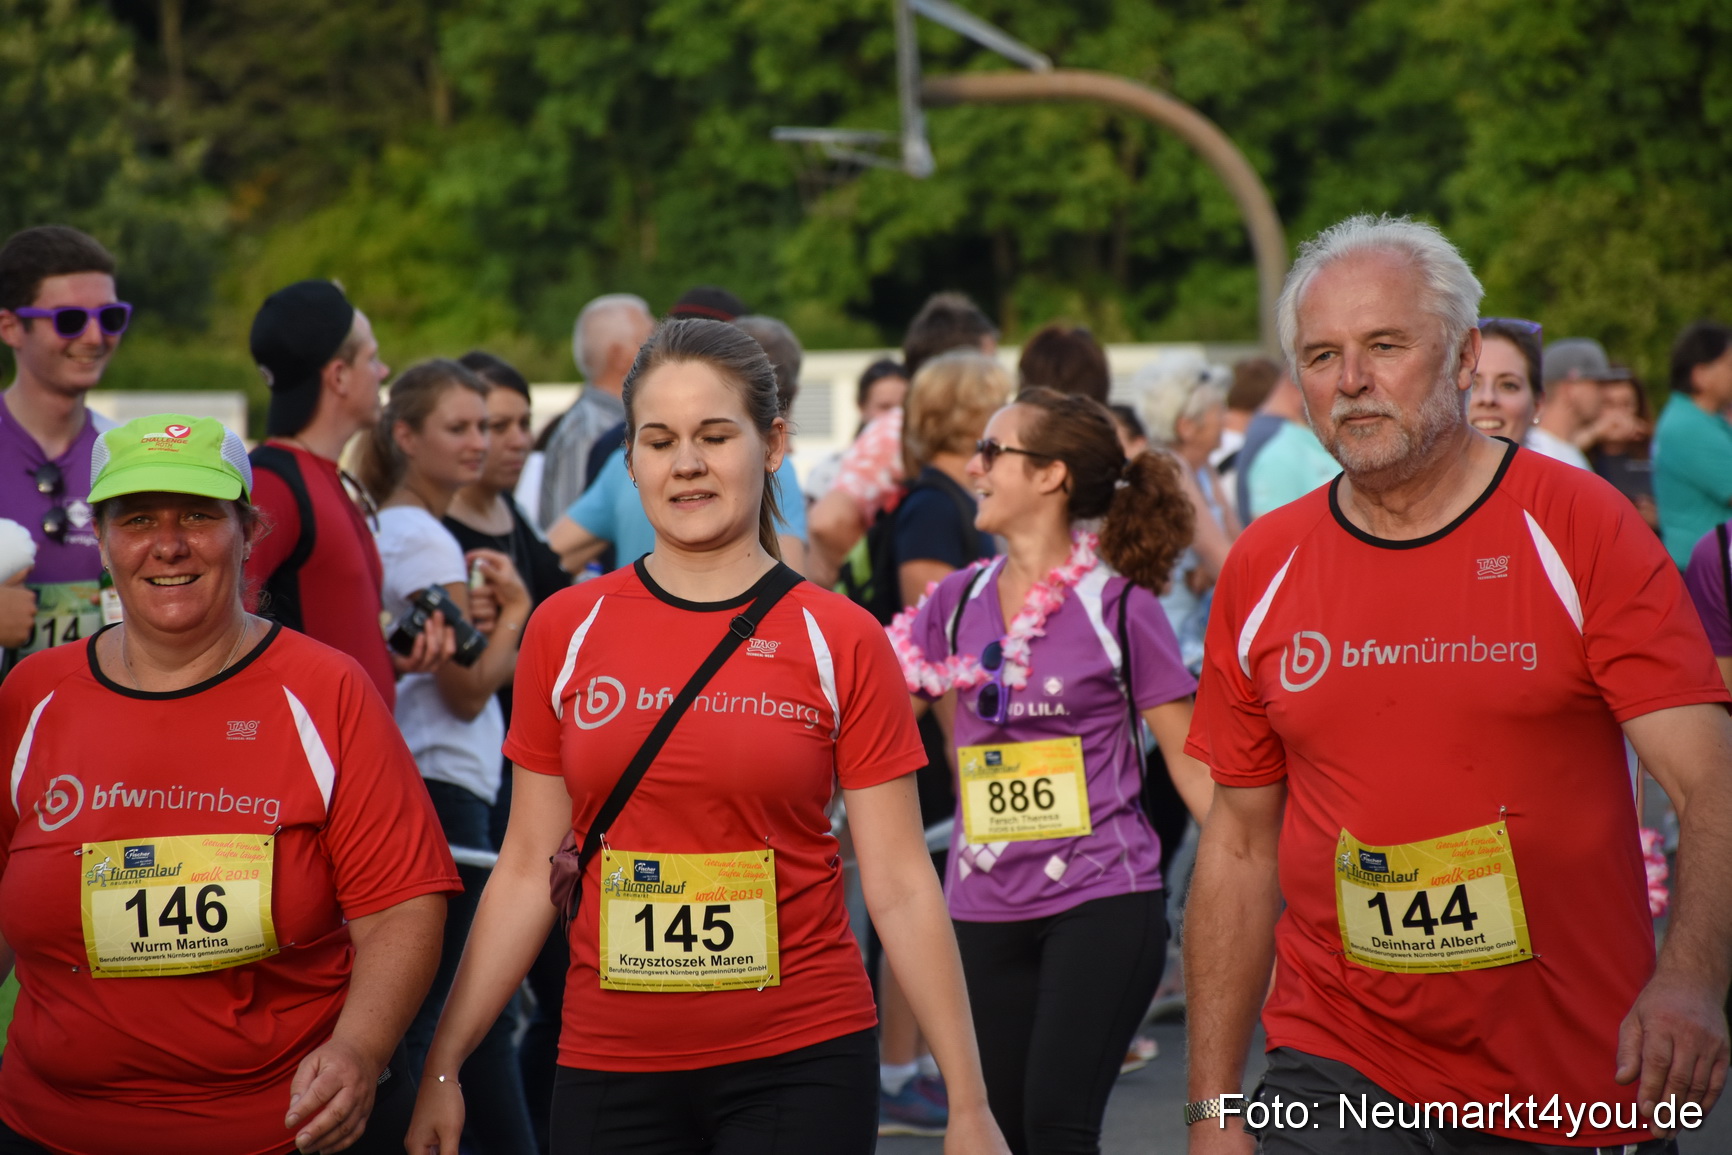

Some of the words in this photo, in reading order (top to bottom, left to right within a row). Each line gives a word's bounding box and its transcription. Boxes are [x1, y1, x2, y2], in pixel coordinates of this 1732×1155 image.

[1476, 555, 1509, 570] TAO
[749, 637, 779, 650] TAO
[1341, 635, 1537, 671] bfwnürnberg
[1028, 702, 1071, 716] LILA.
[226, 720, 258, 731] TAO
[91, 781, 281, 824] bfwnürnberg
[988, 777, 1055, 814] 886
[110, 862, 183, 881] firmenlauf
[190, 866, 223, 882] walk
[225, 869, 260, 881] 2019
[1352, 863, 1419, 884] firmenlauf
[1430, 867, 1464, 886] walk
[1468, 862, 1501, 881] 2019
[623, 878, 687, 894] firmenlauf
[695, 886, 727, 902] walk
[729, 888, 764, 901] 2019
[125, 884, 228, 938] 146
[1367, 884, 1478, 936] 144
[634, 904, 734, 952] 145
[130, 938, 172, 953] Wurm
[176, 937, 228, 950] Martina
[1371, 936, 1436, 950] Deinhard
[1440, 933, 1486, 949] Albert
[1446, 943, 1495, 957] gemeinnützige
[1496, 939, 1517, 949] GmbH
[98, 952, 166, 963] Berufsförderungswerk
[167, 950, 197, 960] Nürnberg
[197, 946, 244, 958] gemeinnützige
[245, 942, 265, 951] GmbH
[619, 953, 706, 969] Krzysztoszek
[710, 954, 753, 966] Maren
[608, 967, 669, 976] Berufsförderungswerk
[701, 967, 746, 976] gemeinnützige
